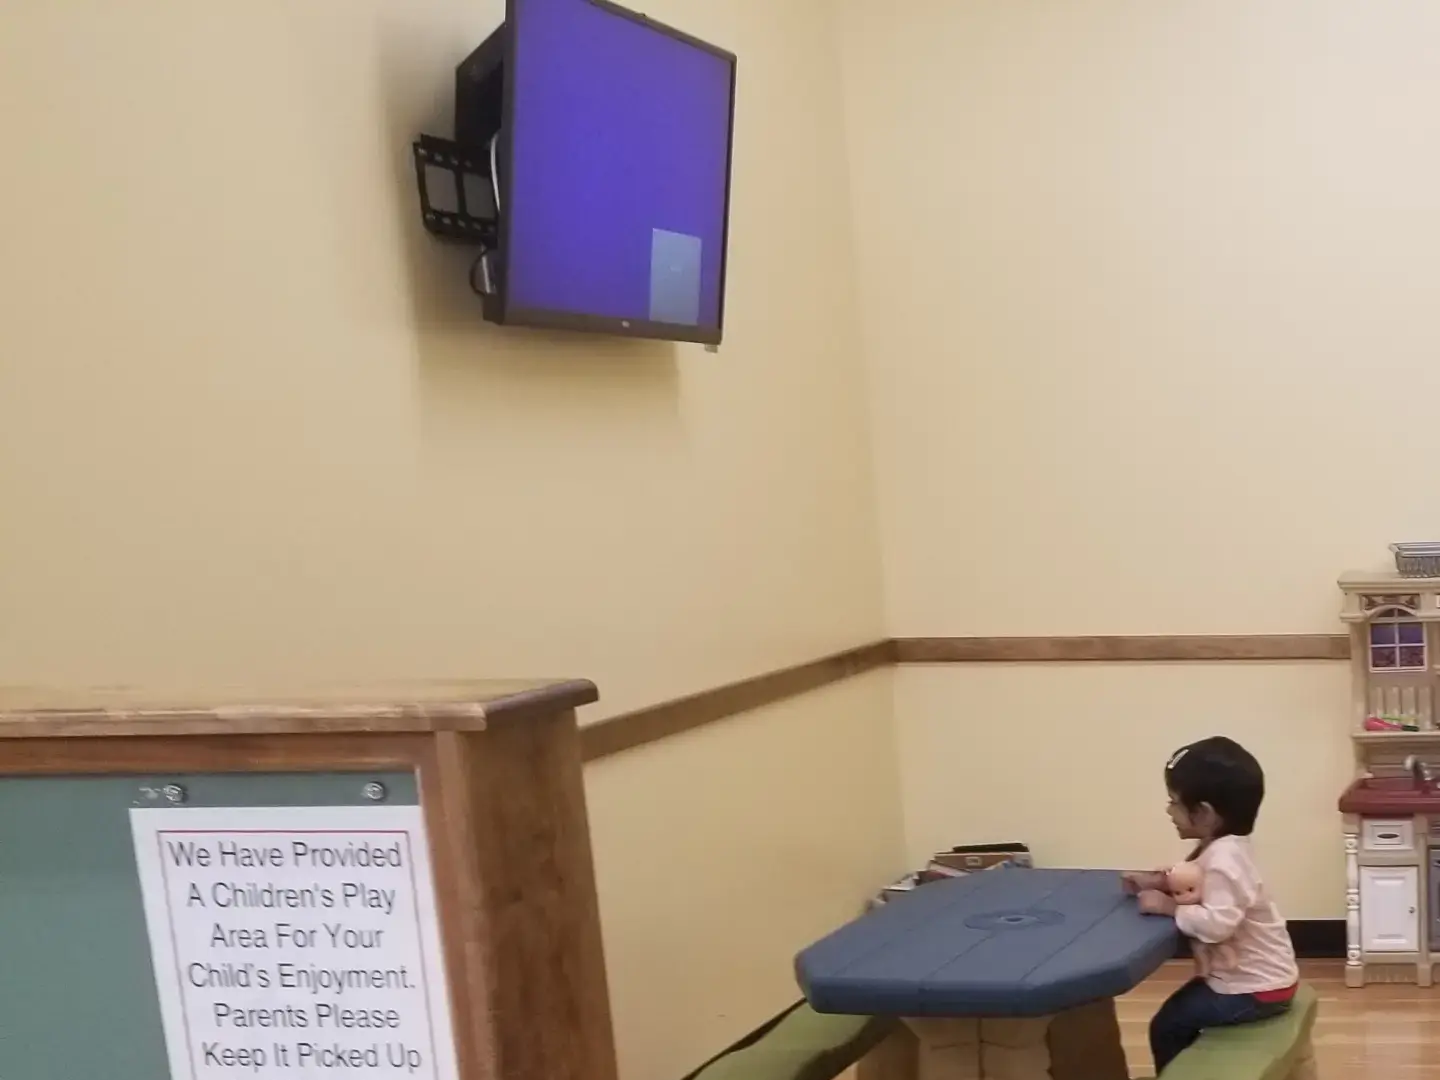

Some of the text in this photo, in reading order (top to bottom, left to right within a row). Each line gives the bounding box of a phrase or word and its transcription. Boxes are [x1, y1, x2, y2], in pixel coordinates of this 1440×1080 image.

[168, 841, 402, 867] We Have Provided
[187, 882, 397, 915] A Children's Play
[210, 922, 385, 948] Area For Your
[188, 962, 416, 995] Child's Enjoyment.
[213, 1002, 401, 1029] Parents Please
[202, 1041, 422, 1074] Keep It Picked Up
